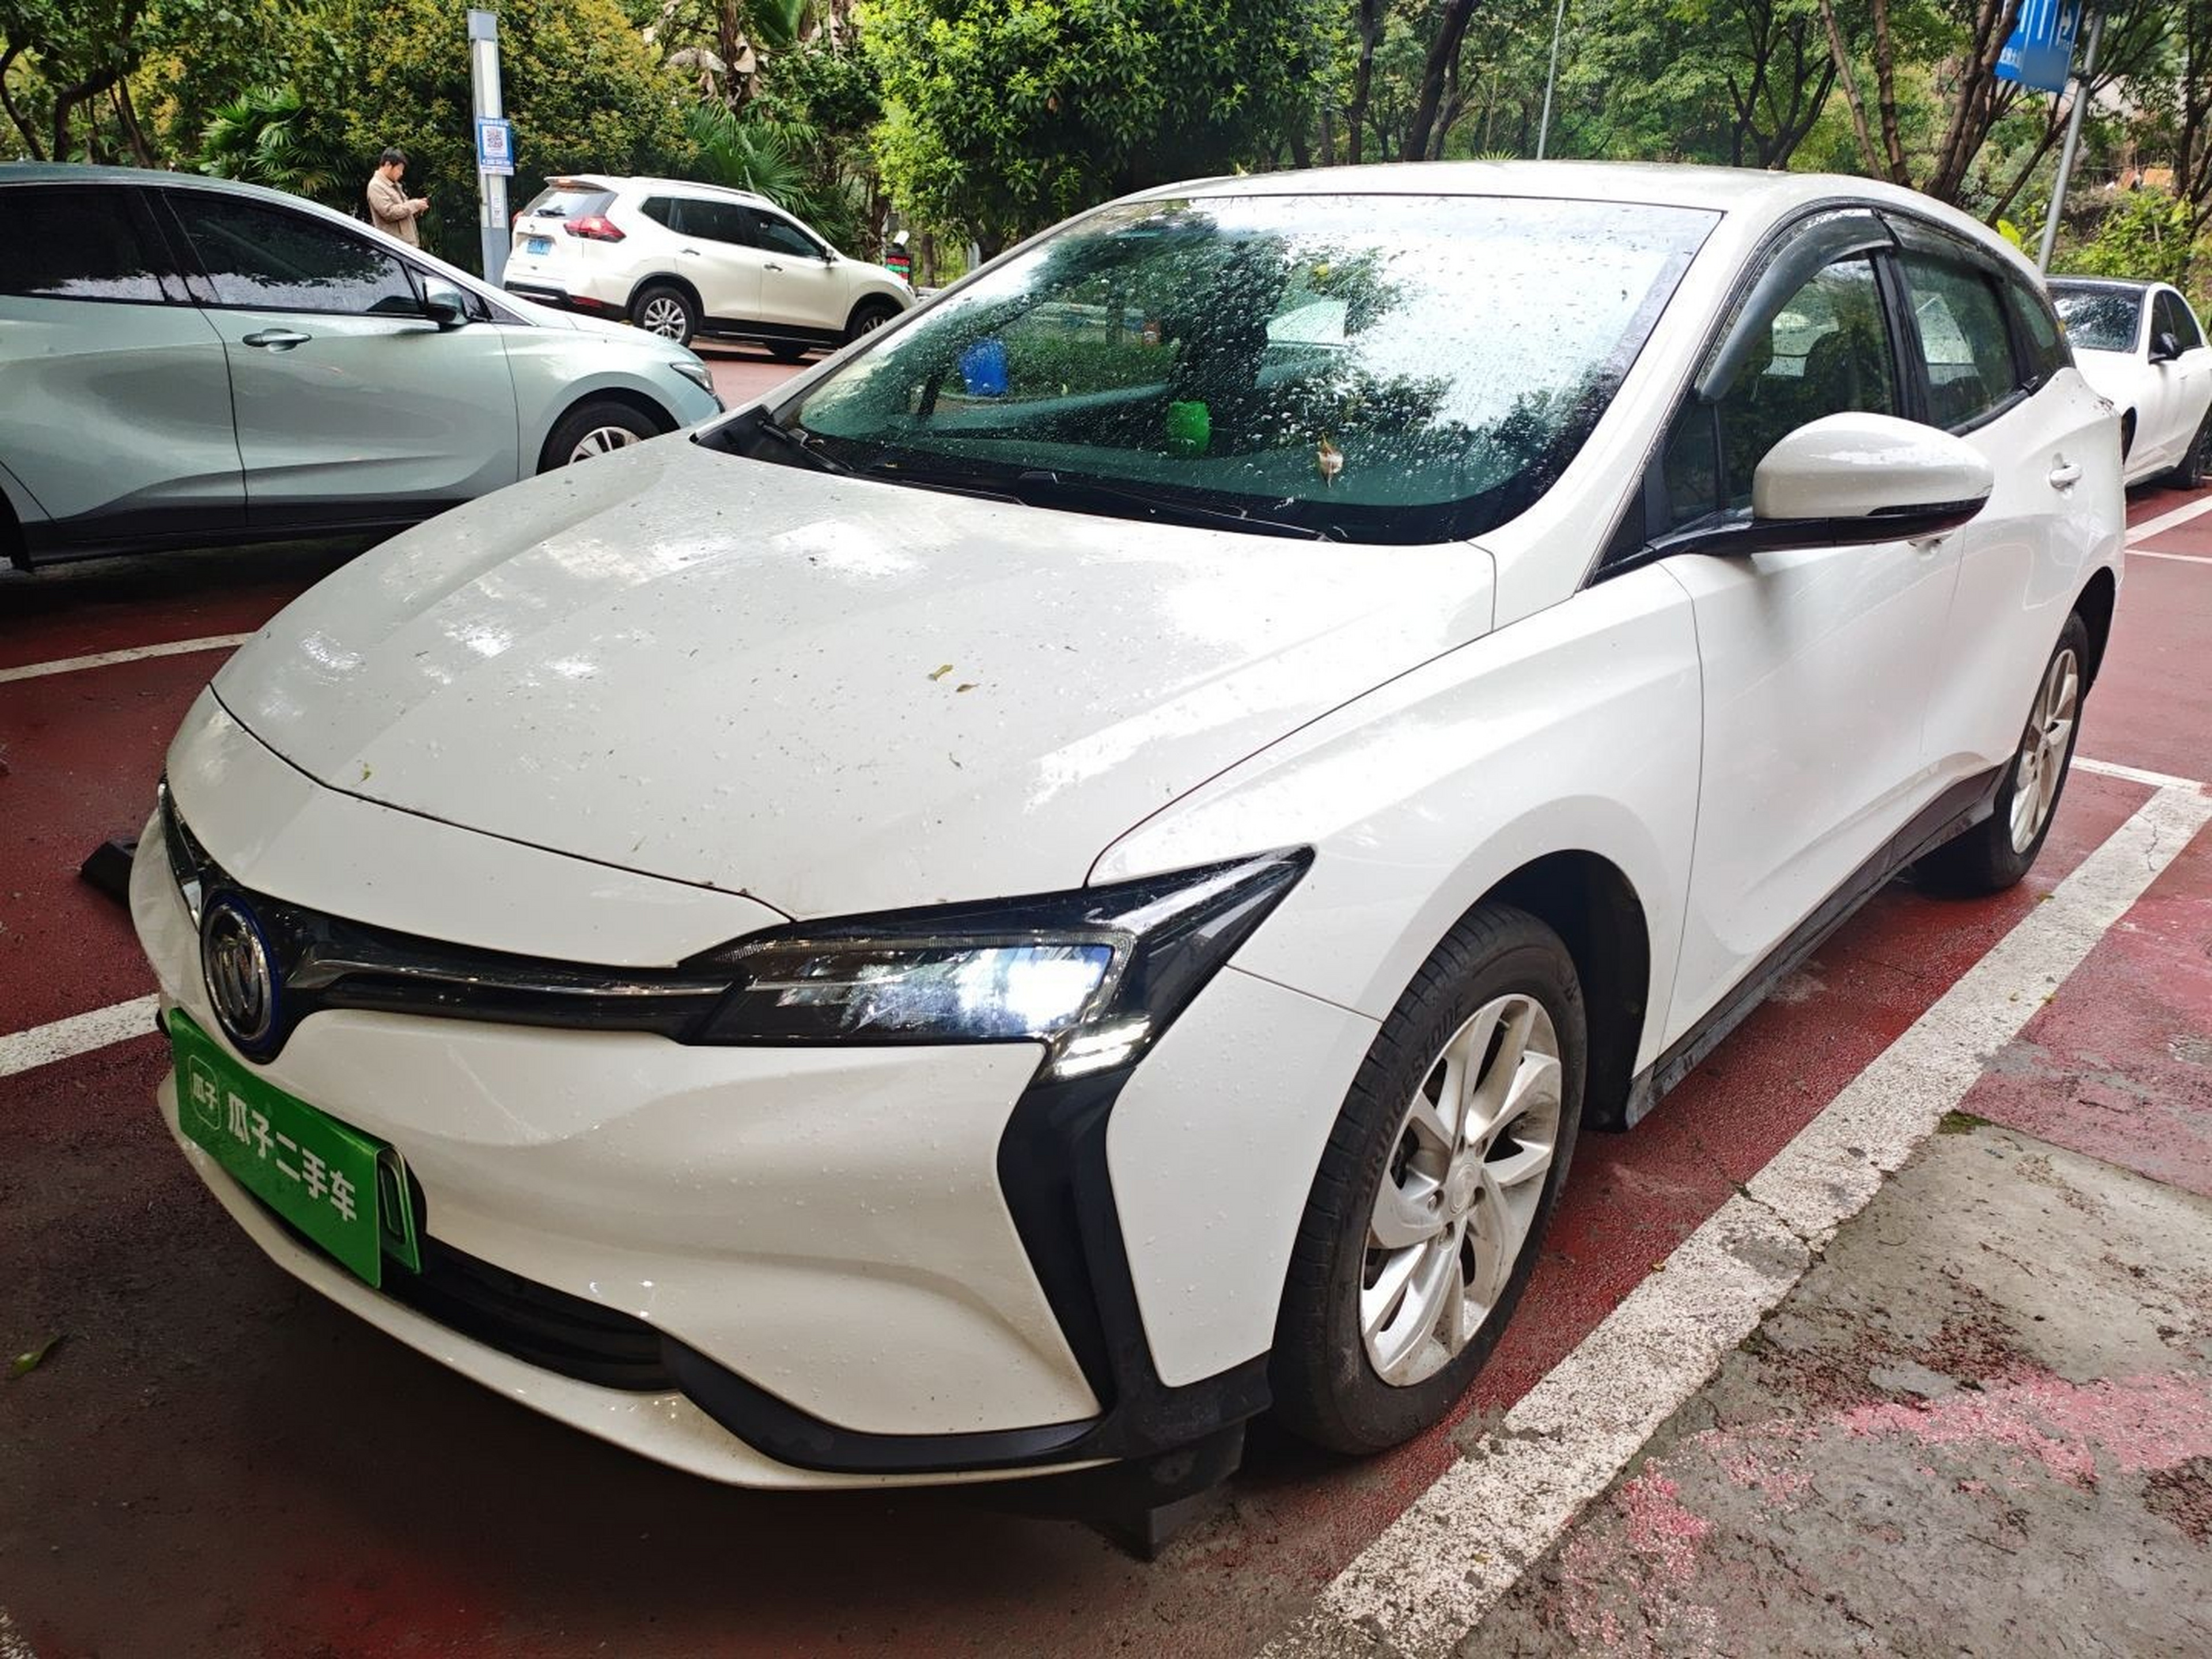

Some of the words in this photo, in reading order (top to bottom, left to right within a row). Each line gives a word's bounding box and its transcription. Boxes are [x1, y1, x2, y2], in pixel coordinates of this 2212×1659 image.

[192, 1072, 218, 1110] 瓜子
[228, 1092, 357, 1221] 瓜子二手车
